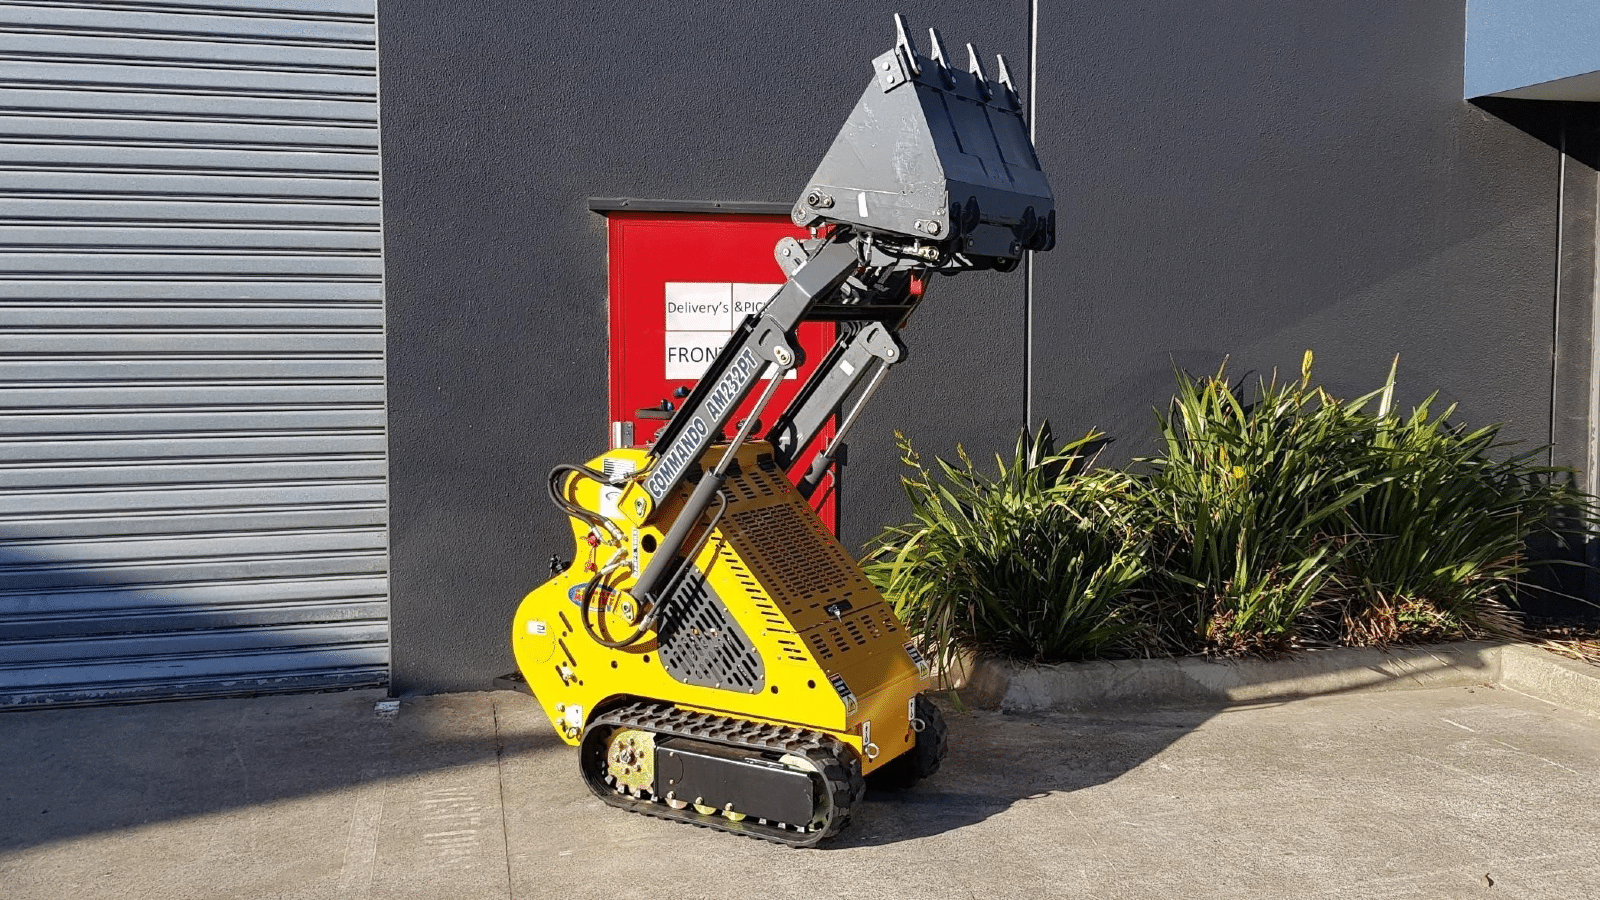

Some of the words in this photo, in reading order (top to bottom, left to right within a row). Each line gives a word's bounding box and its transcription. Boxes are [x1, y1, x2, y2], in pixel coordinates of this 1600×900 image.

[668, 301, 729, 314] Delivery's
[734, 301, 766, 313] &PIC
[668, 346, 723, 363] FRON
[648, 417, 708, 498] COMMANDO
[706, 347, 758, 422] AM232PT
